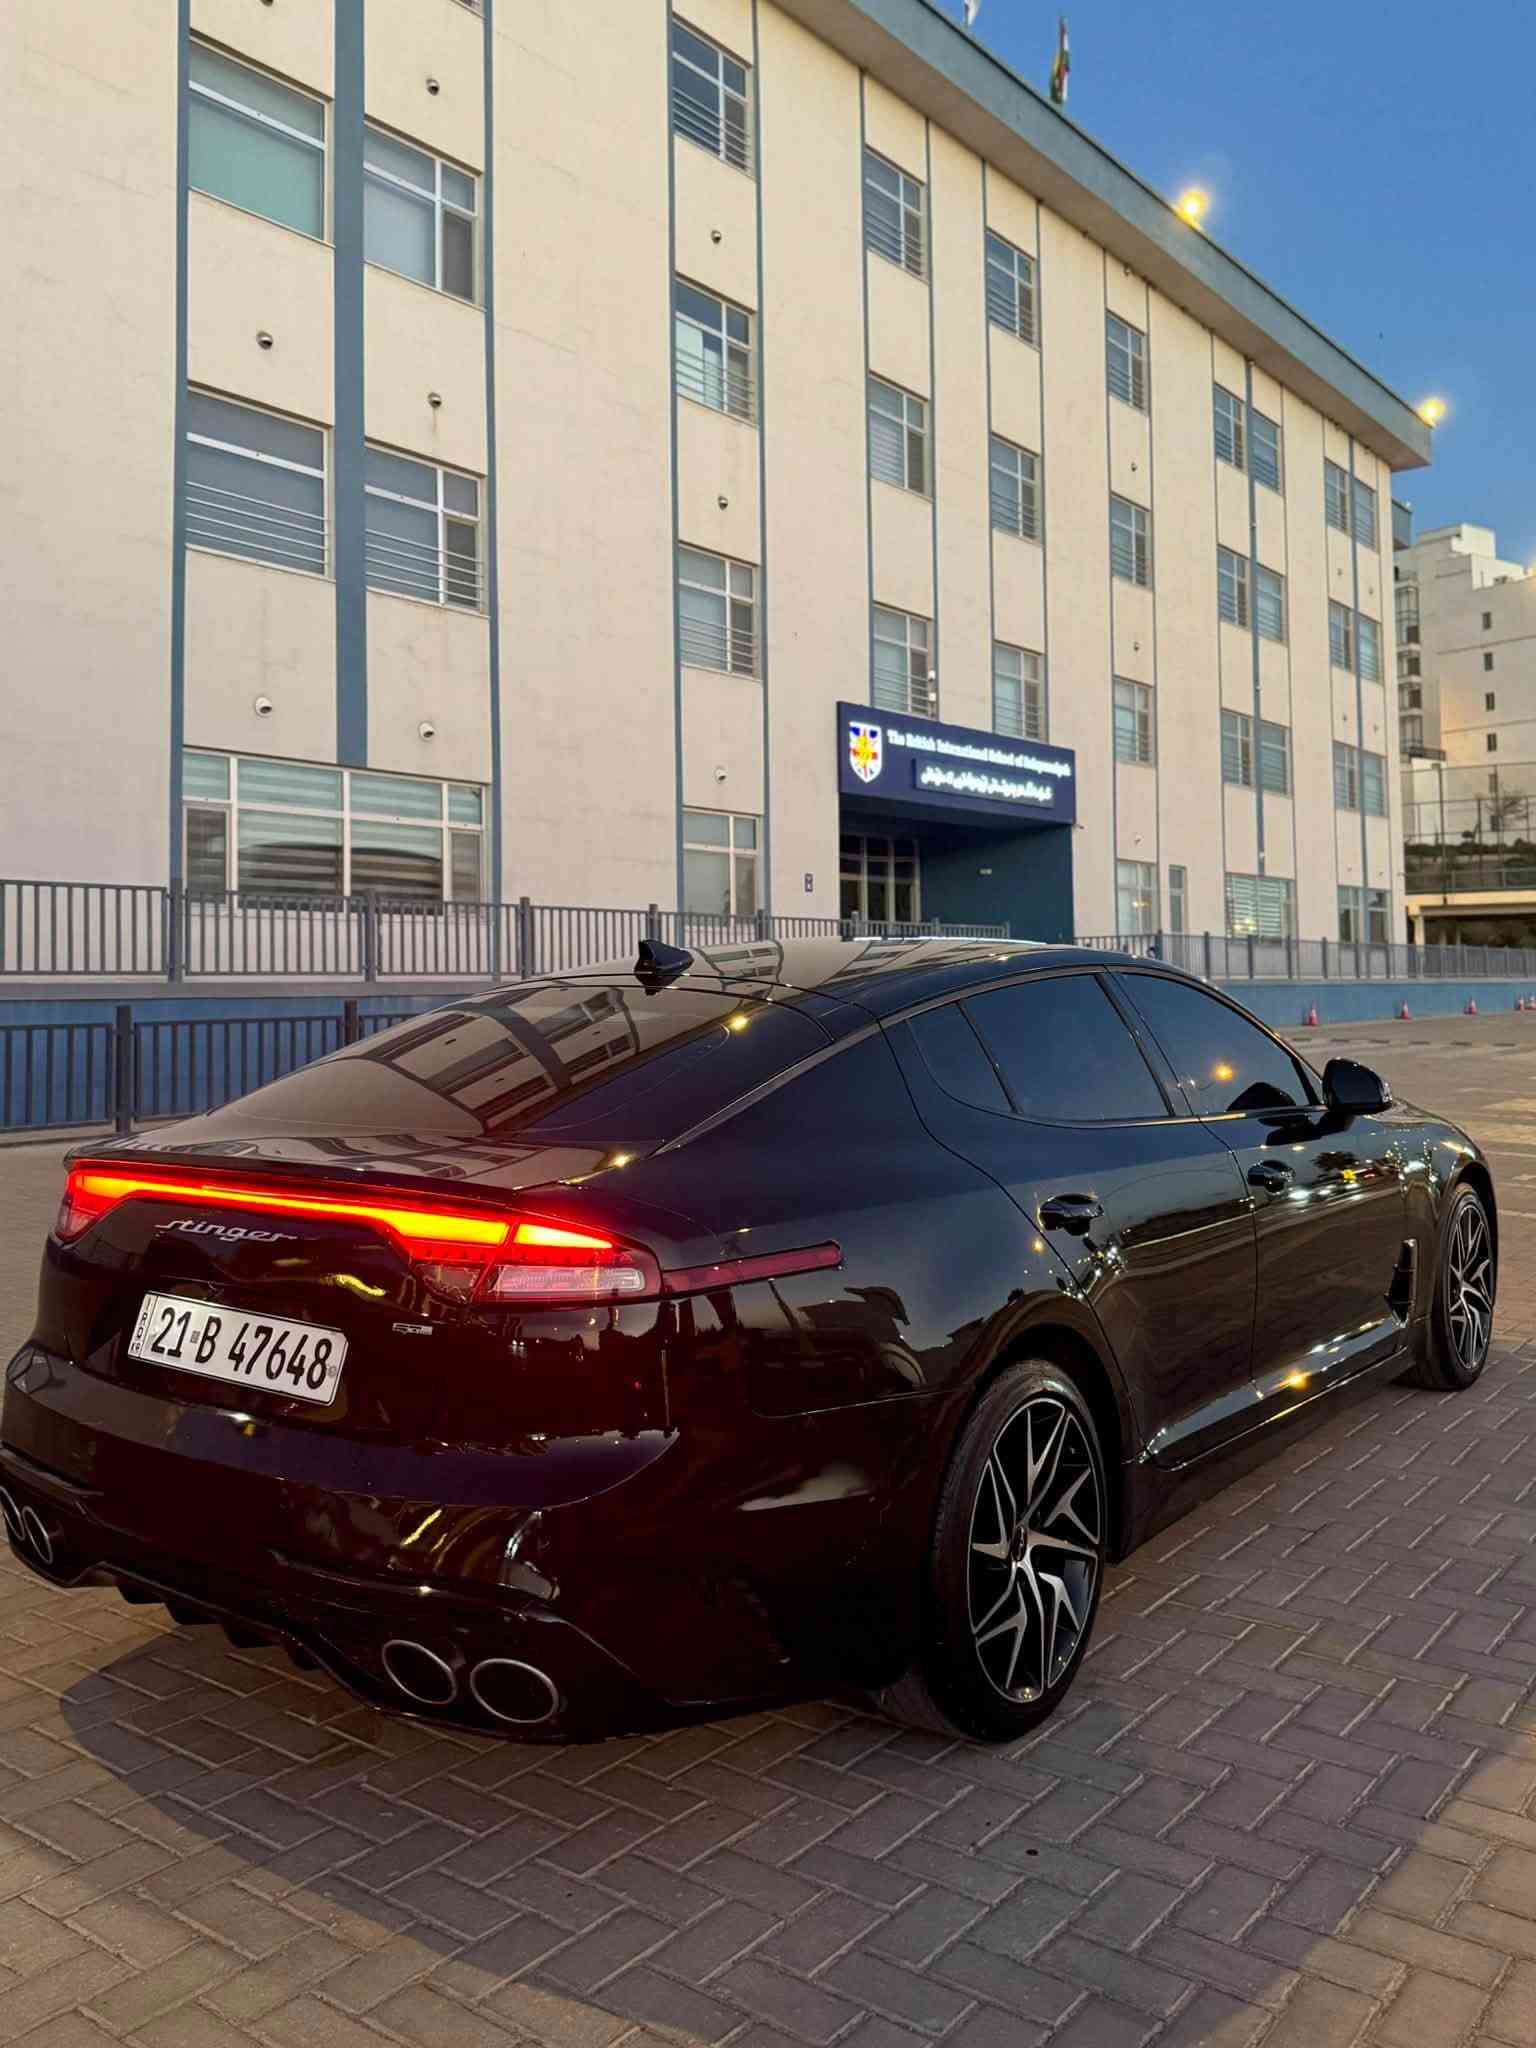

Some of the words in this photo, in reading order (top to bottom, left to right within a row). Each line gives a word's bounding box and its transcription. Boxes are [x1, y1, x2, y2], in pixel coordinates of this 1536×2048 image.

[887, 729, 905, 746] The
[150, 1307, 193, 1358] 21
[195, 1315, 222, 1363] B
[227, 1322, 332, 1389] 47648
